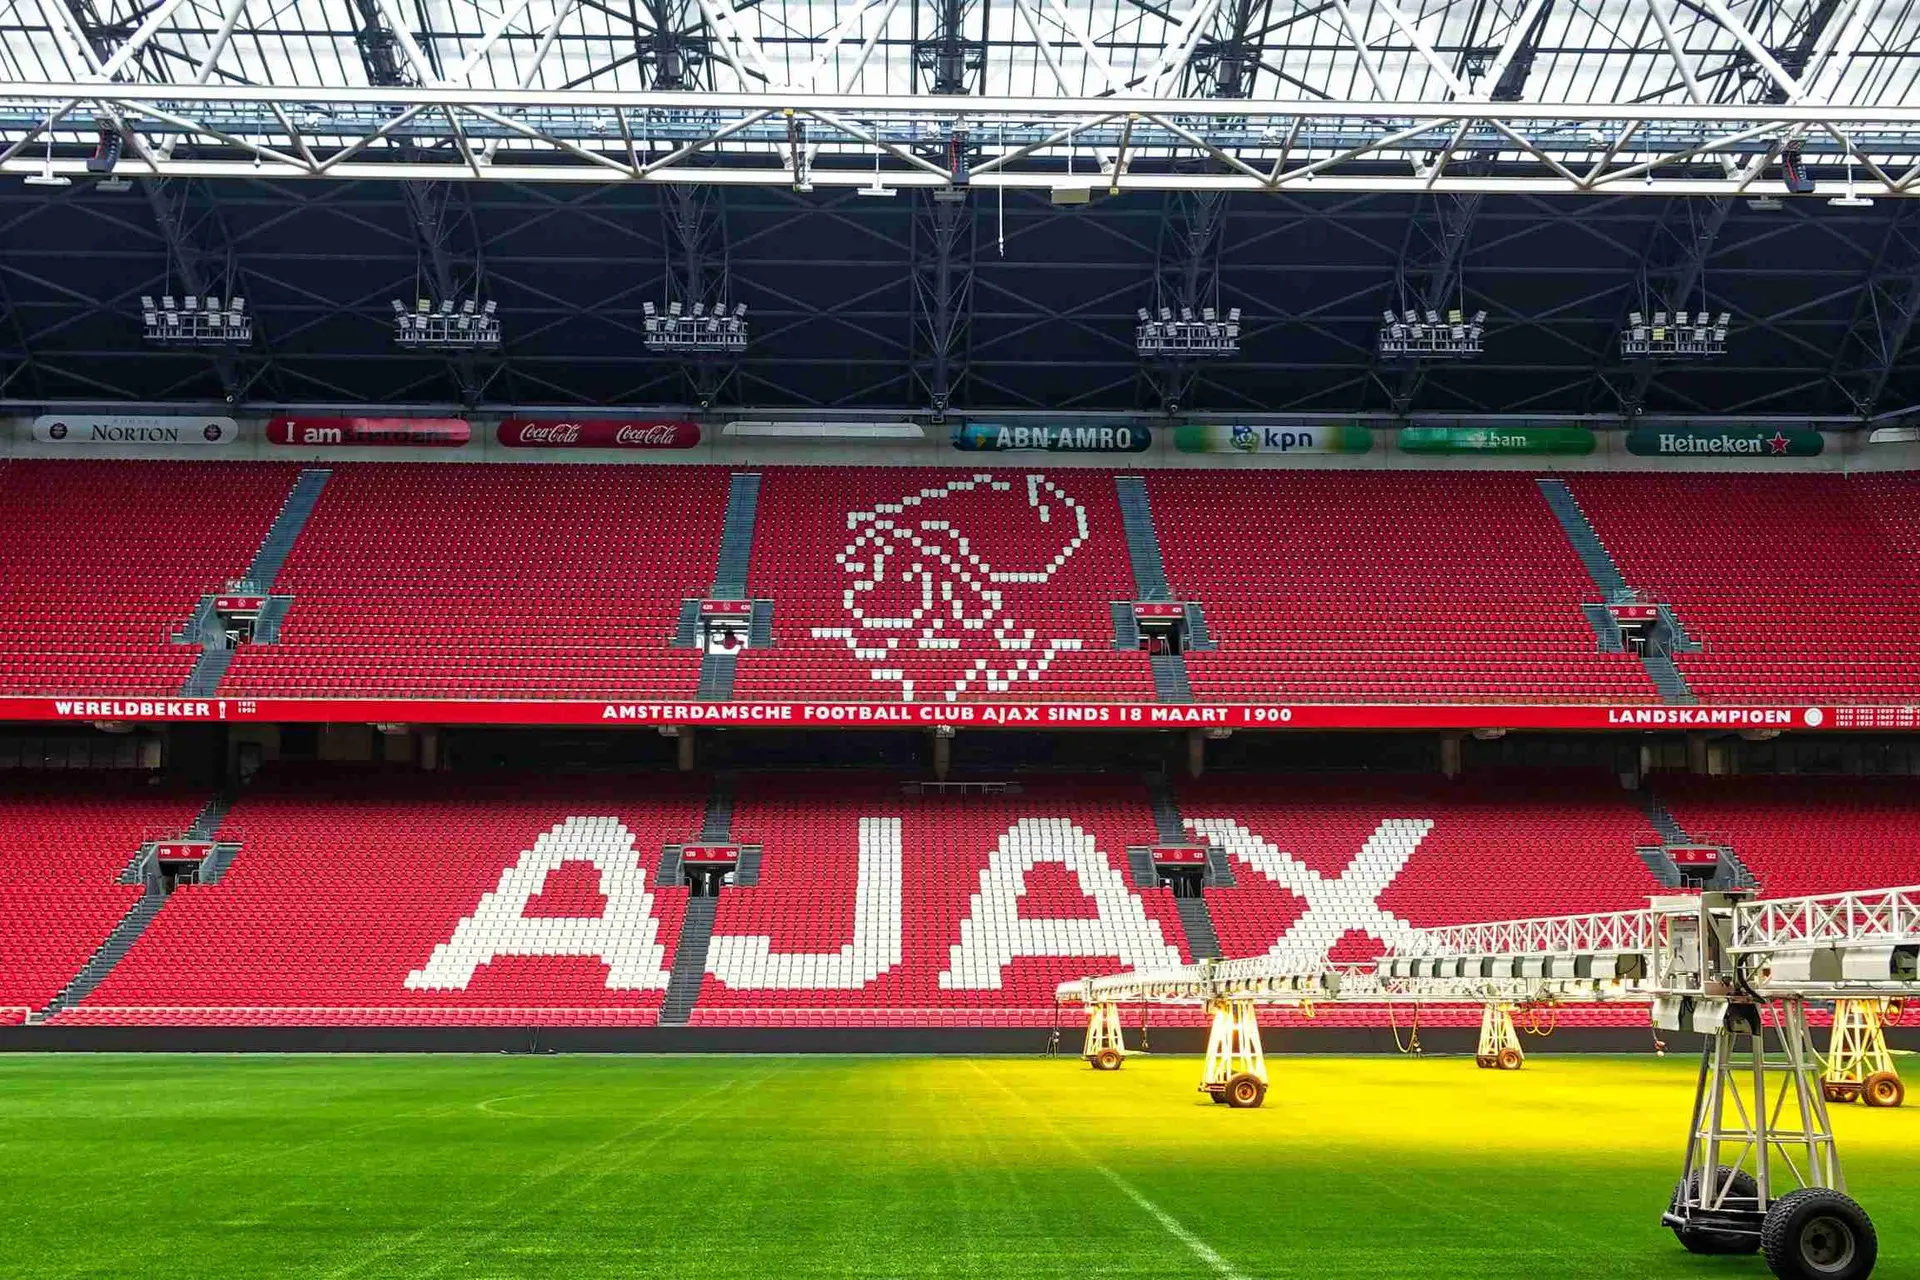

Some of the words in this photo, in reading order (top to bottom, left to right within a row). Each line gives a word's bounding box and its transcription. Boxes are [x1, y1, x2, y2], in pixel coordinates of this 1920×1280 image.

[91, 424, 180, 441] NORTON
[286, 422, 295, 442] I
[1264, 428, 1313, 451] kpn
[1659, 434, 1762, 453] Heineken
[55, 701, 210, 716] WERELDBEKER
[602, 705, 792, 720] AMSTERDAMSCHE
[803, 706, 911, 720] FOOTBALL
[919, 706, 974, 721] CLUB
[982, 707, 1040, 724] AJAX
[1048, 707, 1109, 721] SINDS
[1119, 707, 1142, 721] 18
[1151, 708, 1228, 722] MAART
[1243, 708, 1292, 722] 1900
[1608, 710, 1791, 723] LANDSKAMPIOEN
[403, 816, 1435, 991] AJAX
